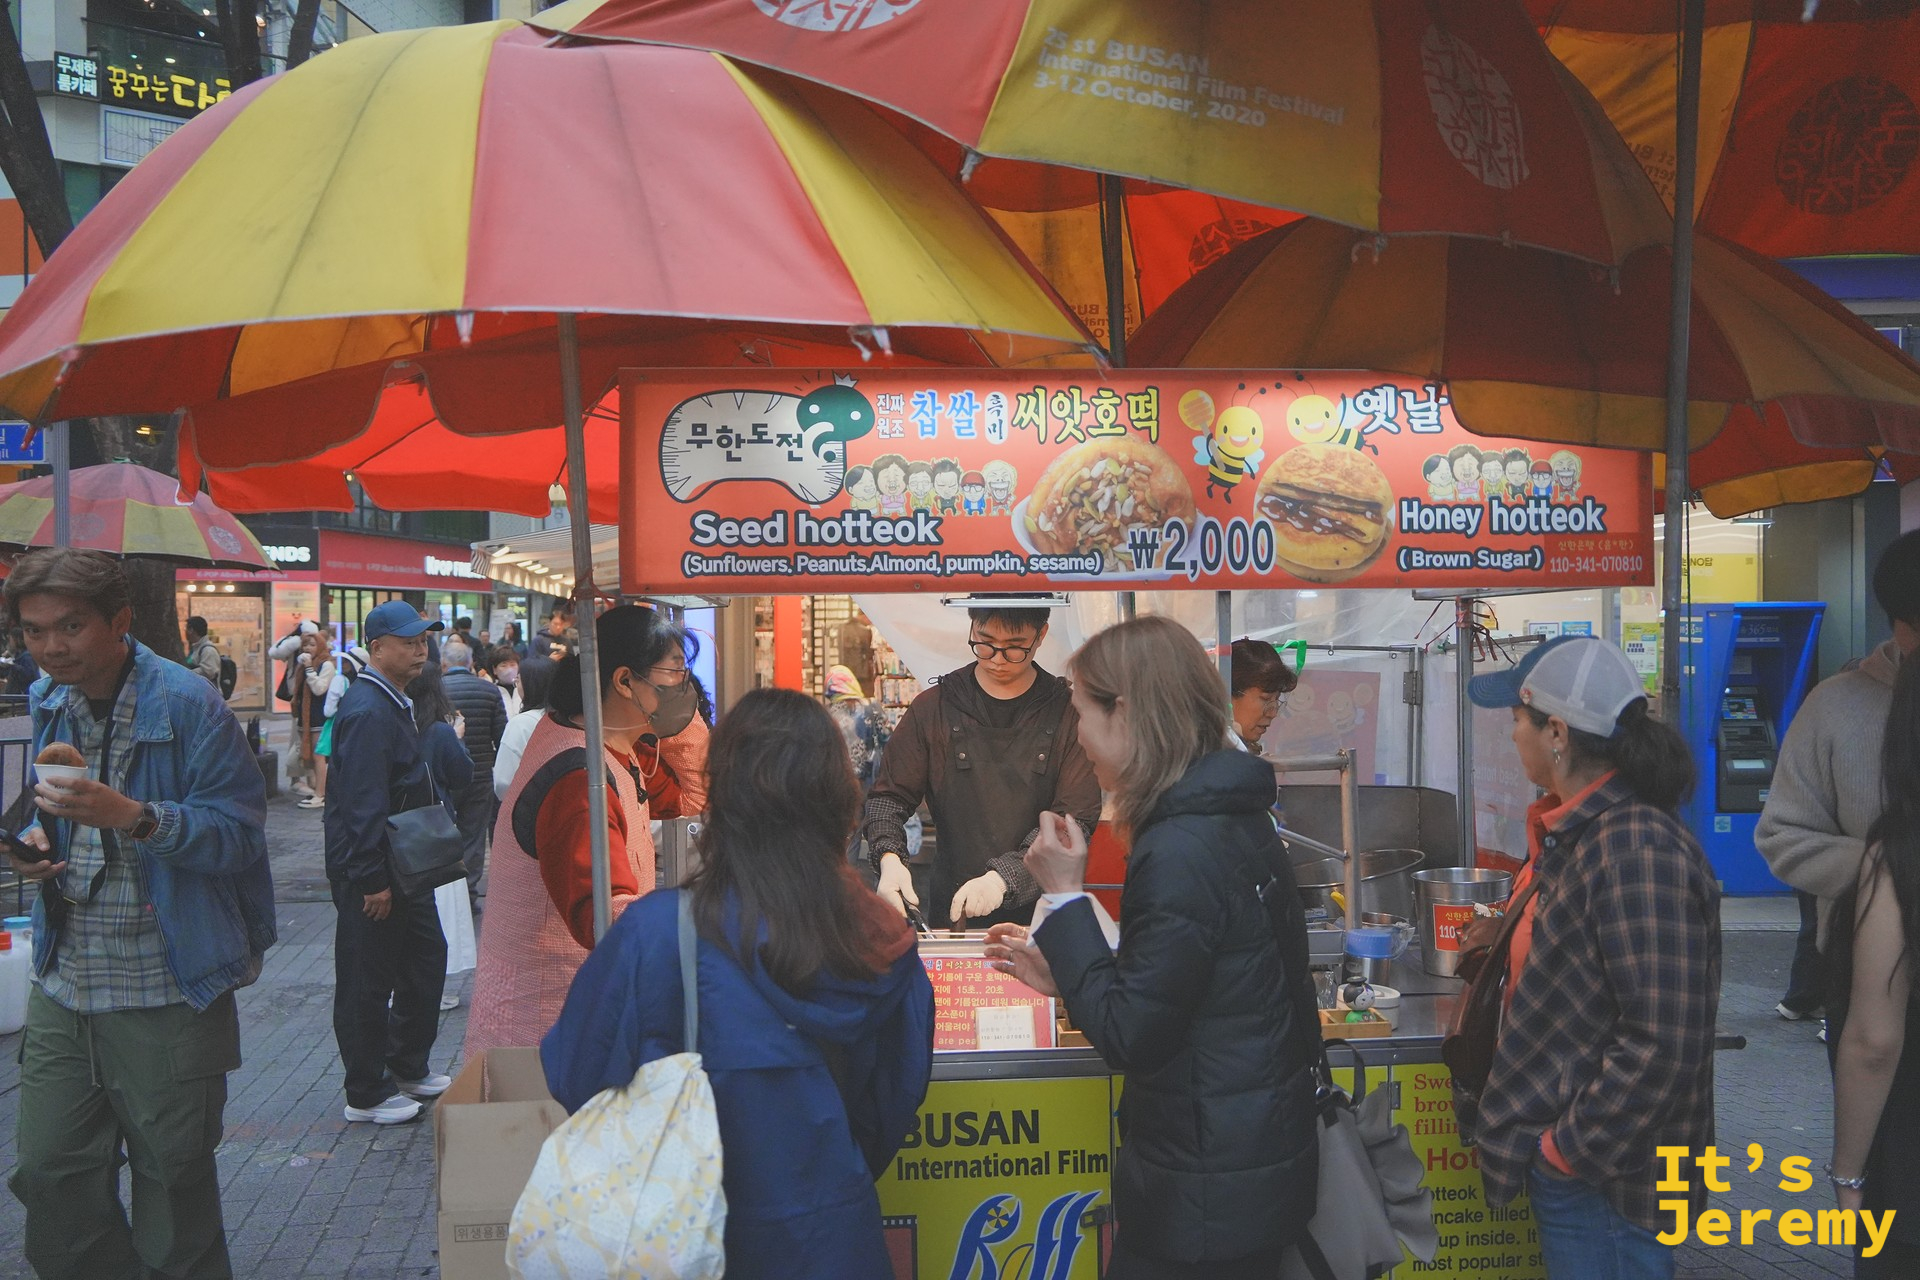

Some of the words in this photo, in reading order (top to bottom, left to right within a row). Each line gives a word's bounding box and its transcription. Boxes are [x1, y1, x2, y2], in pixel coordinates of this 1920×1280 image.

[57, 55, 97, 79] 무제한
[1105, 39, 1210, 75] BUSAN
[57, 74, 98, 97] 룸카페
[107, 66, 169, 102] 꿈꾸는
[1038, 47, 1190, 92] International
[1197, 75, 1247, 100] Film
[1253, 85, 1345, 126] Festival
[1090, 79, 1199, 119] October,
[1206, 100, 1267, 127] 2020
[876, 394, 905, 415] 진짜
[987, 394, 1004, 440] 흑미
[1012, 385, 1160, 444] 씨앗호떡
[1354, 384, 1449, 434] 옛날
[686, 423, 803, 462] 무한도전
[876, 418, 905, 439] 원조
[692, 511, 786, 545] Seed
[797, 511, 941, 545] hotteok
[1401, 500, 1483, 535] Honey
[1491, 498, 1605, 533] hotteok
[684, 554, 793, 575] (Sunflowers.
[946, 553, 1026, 575] pumpkin,
[1029, 554, 1101, 574] sesame)
[1128, 518, 1276, 581] ₩2,000
[1549, 556, 1643, 573] 110-341-070810
[1446, 912, 1474, 921] 신한은
[985, 985, 1004, 994] 20초
[899, 1109, 1040, 1150] BUSAN
[897, 1151, 1050, 1181] International
[1058, 1149, 1108, 1175] Film
[1489, 1205, 1530, 1222] filled
[1438, 1234, 1460, 1249] up
[1465, 1230, 1520, 1247] inside.
[1458, 1252, 1522, 1272] popular
